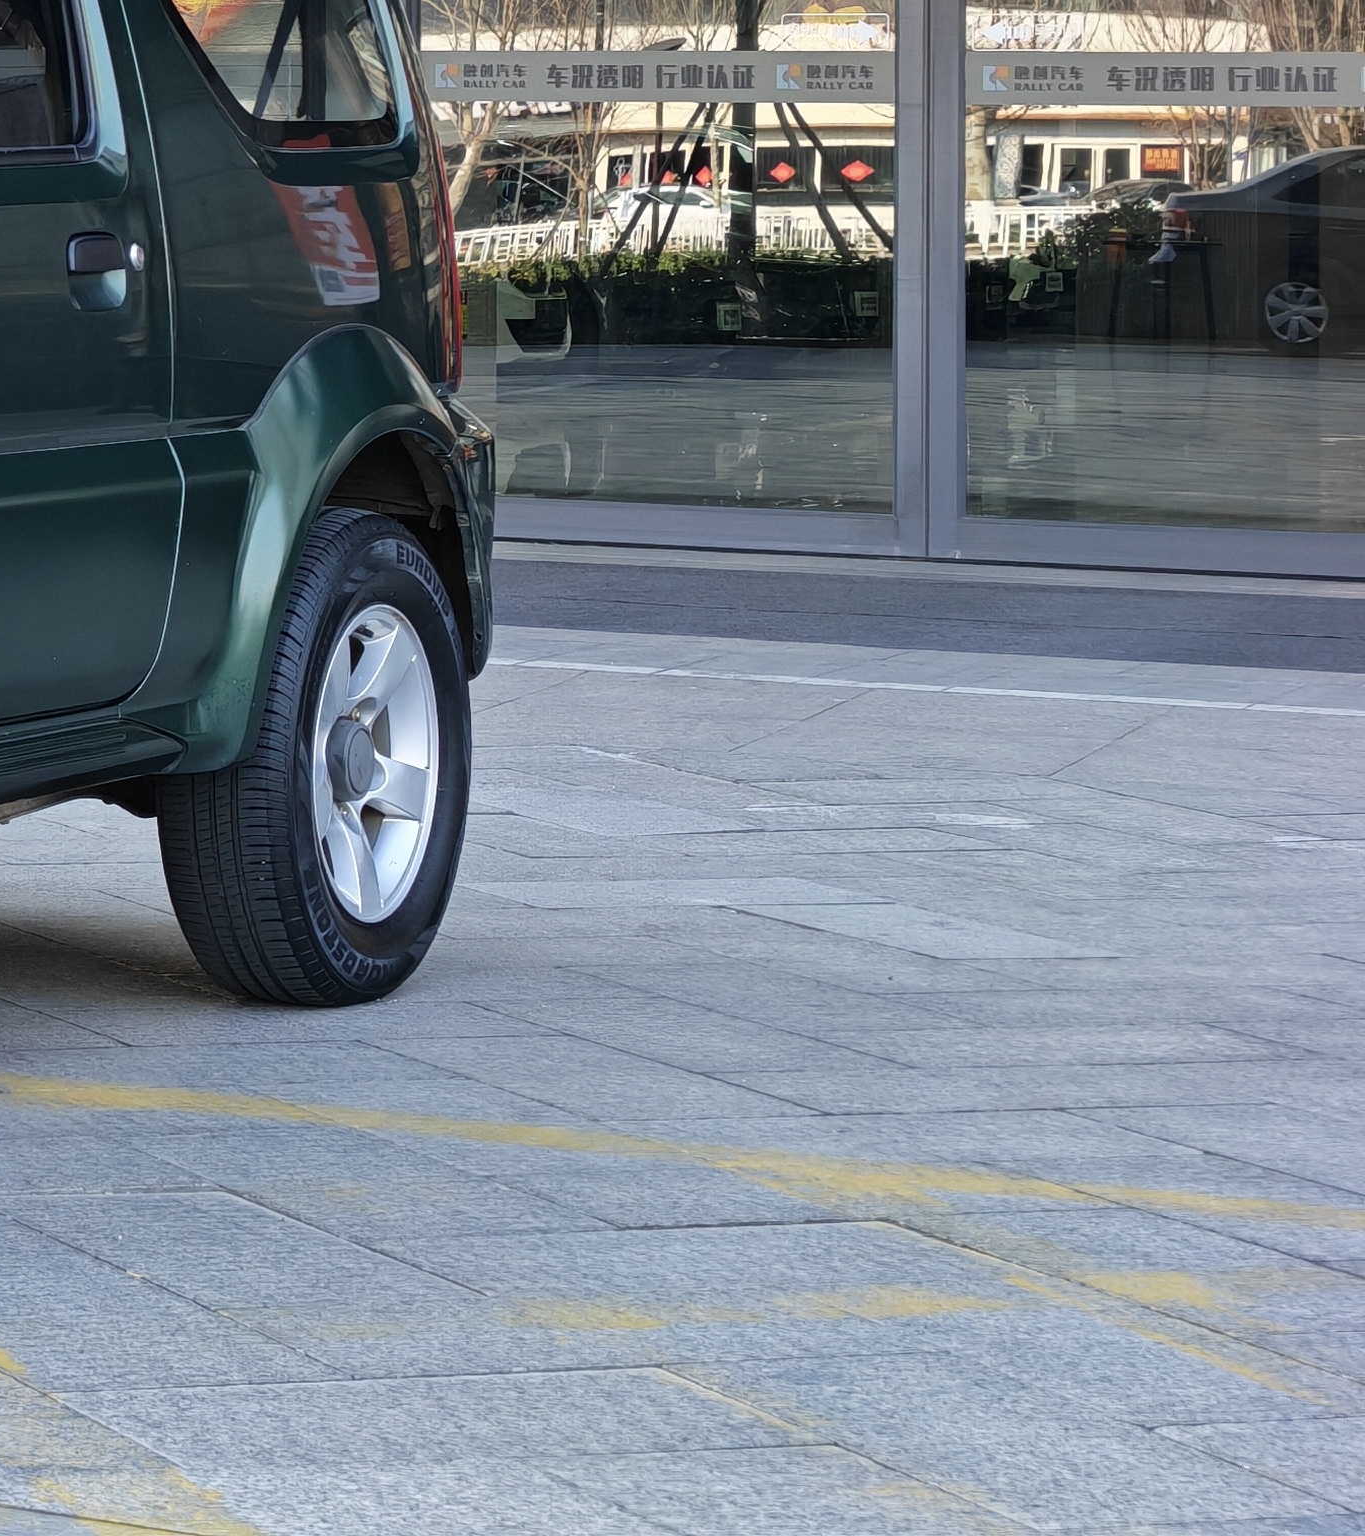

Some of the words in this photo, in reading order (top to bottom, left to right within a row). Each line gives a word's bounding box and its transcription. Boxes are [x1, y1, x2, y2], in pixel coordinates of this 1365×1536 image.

[462, 64, 528, 78] 融创汽车
[546, 64, 644, 89] 车况透明
[655, 64, 756, 90] 行业认证
[806, 64, 874, 79] 融创汽车
[463, 80, 498, 89] RALLY
[502, 80, 527, 89] CAR
[806, 81, 843, 90] RALLY
[848, 81, 874, 90] CAR
[1106, 65, 1215, 92] 车况透明
[1227, 66, 1339, 93] 行业认证
[1014, 82, 1054, 91] RALLY
[1058, 82, 1084, 91] CAR
[303, 870, 398, 984] ROADSTON
